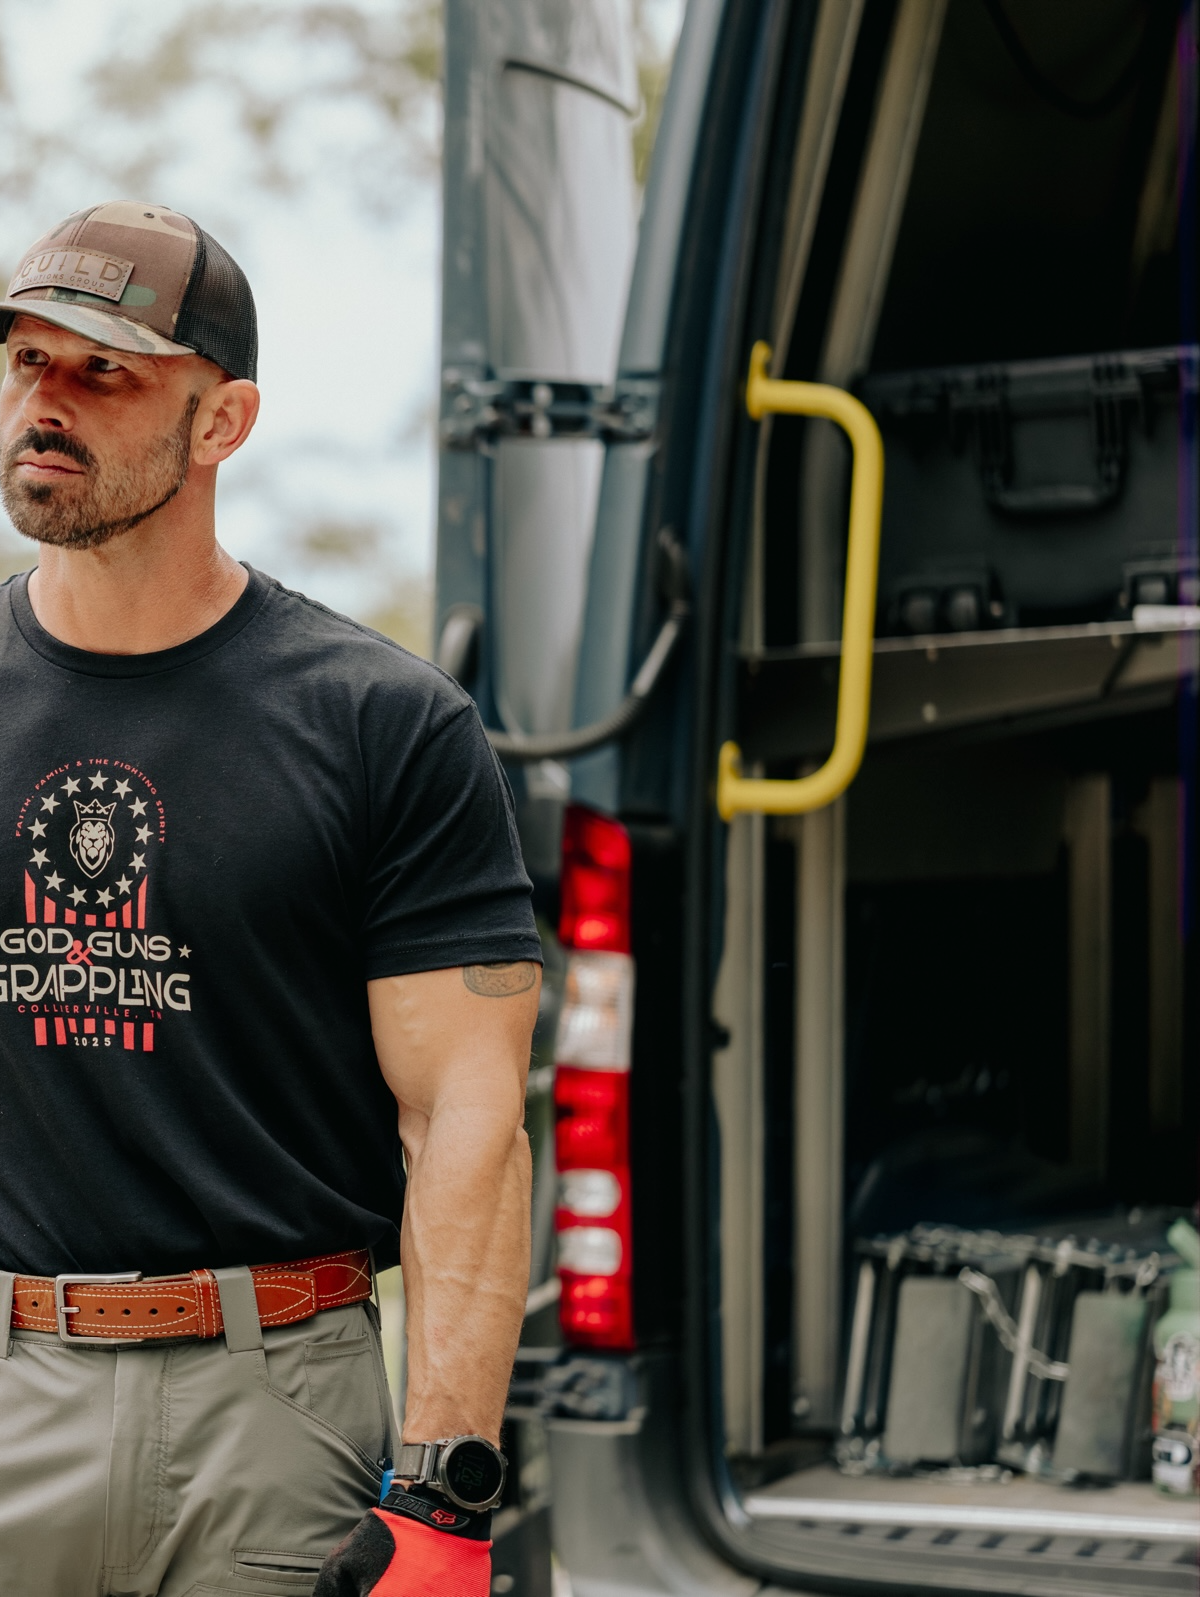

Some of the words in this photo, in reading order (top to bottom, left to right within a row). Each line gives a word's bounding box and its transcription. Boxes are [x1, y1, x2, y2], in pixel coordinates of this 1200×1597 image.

[21, 254, 123, 282] GUILD
[21, 273, 64, 285] SOLUTIONS
[69, 275, 105, 288] GROUP
[35, 763, 70, 790] FAMILY
[113, 760, 157, 795] FIGHTING
[155, 800, 166, 843] SPIRIT
[0, 928, 74, 954] GOD
[66, 939, 94, 966] &
[87, 932, 172, 961] GUNS
[150, 1009, 162, 1020] TN
[74, 1037, 112, 1047] 2025
